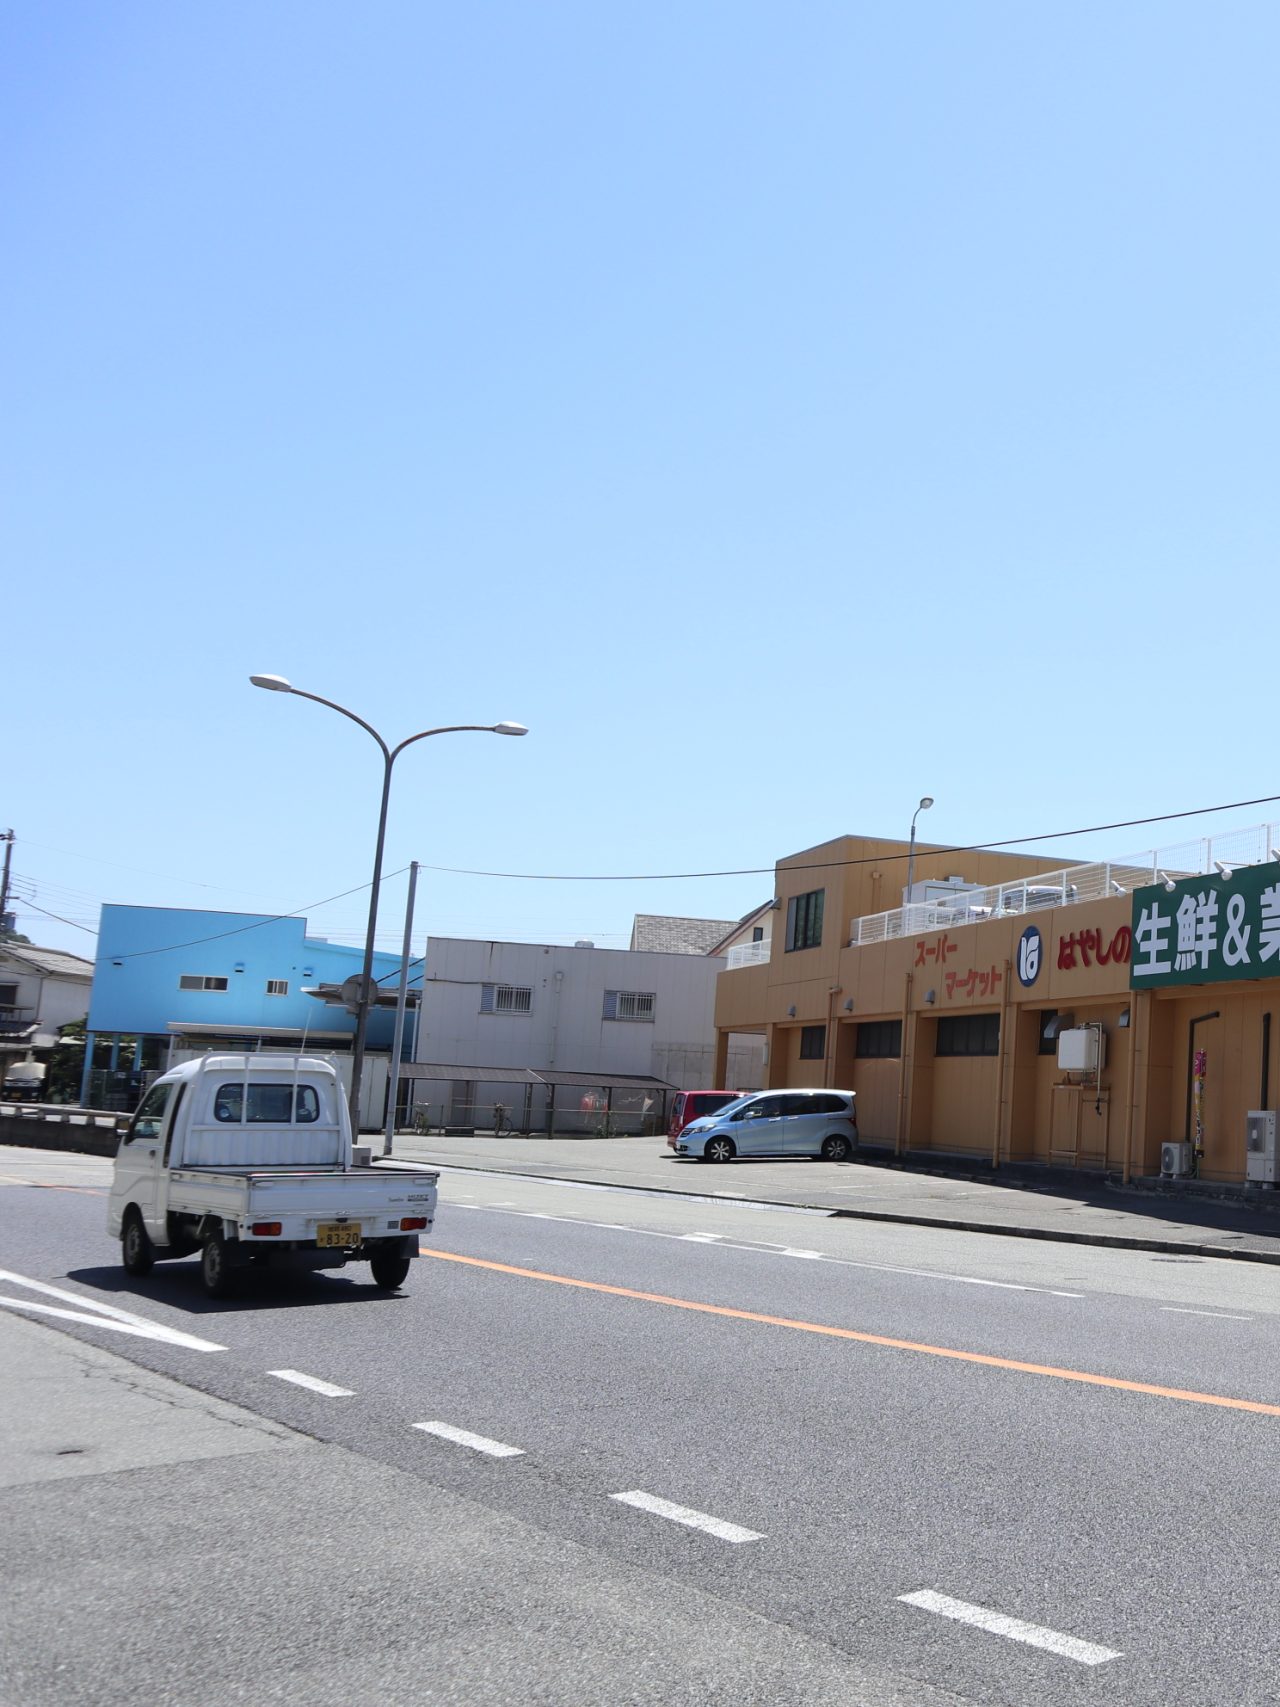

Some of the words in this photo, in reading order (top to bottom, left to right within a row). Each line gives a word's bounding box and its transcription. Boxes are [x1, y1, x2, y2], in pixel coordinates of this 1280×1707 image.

[915, 934, 958, 967] スーパー
[1057, 926, 1131, 970] はやしの
[945, 965, 1002, 999] マーケット
[327, 1233, 359, 1245] 83-20
